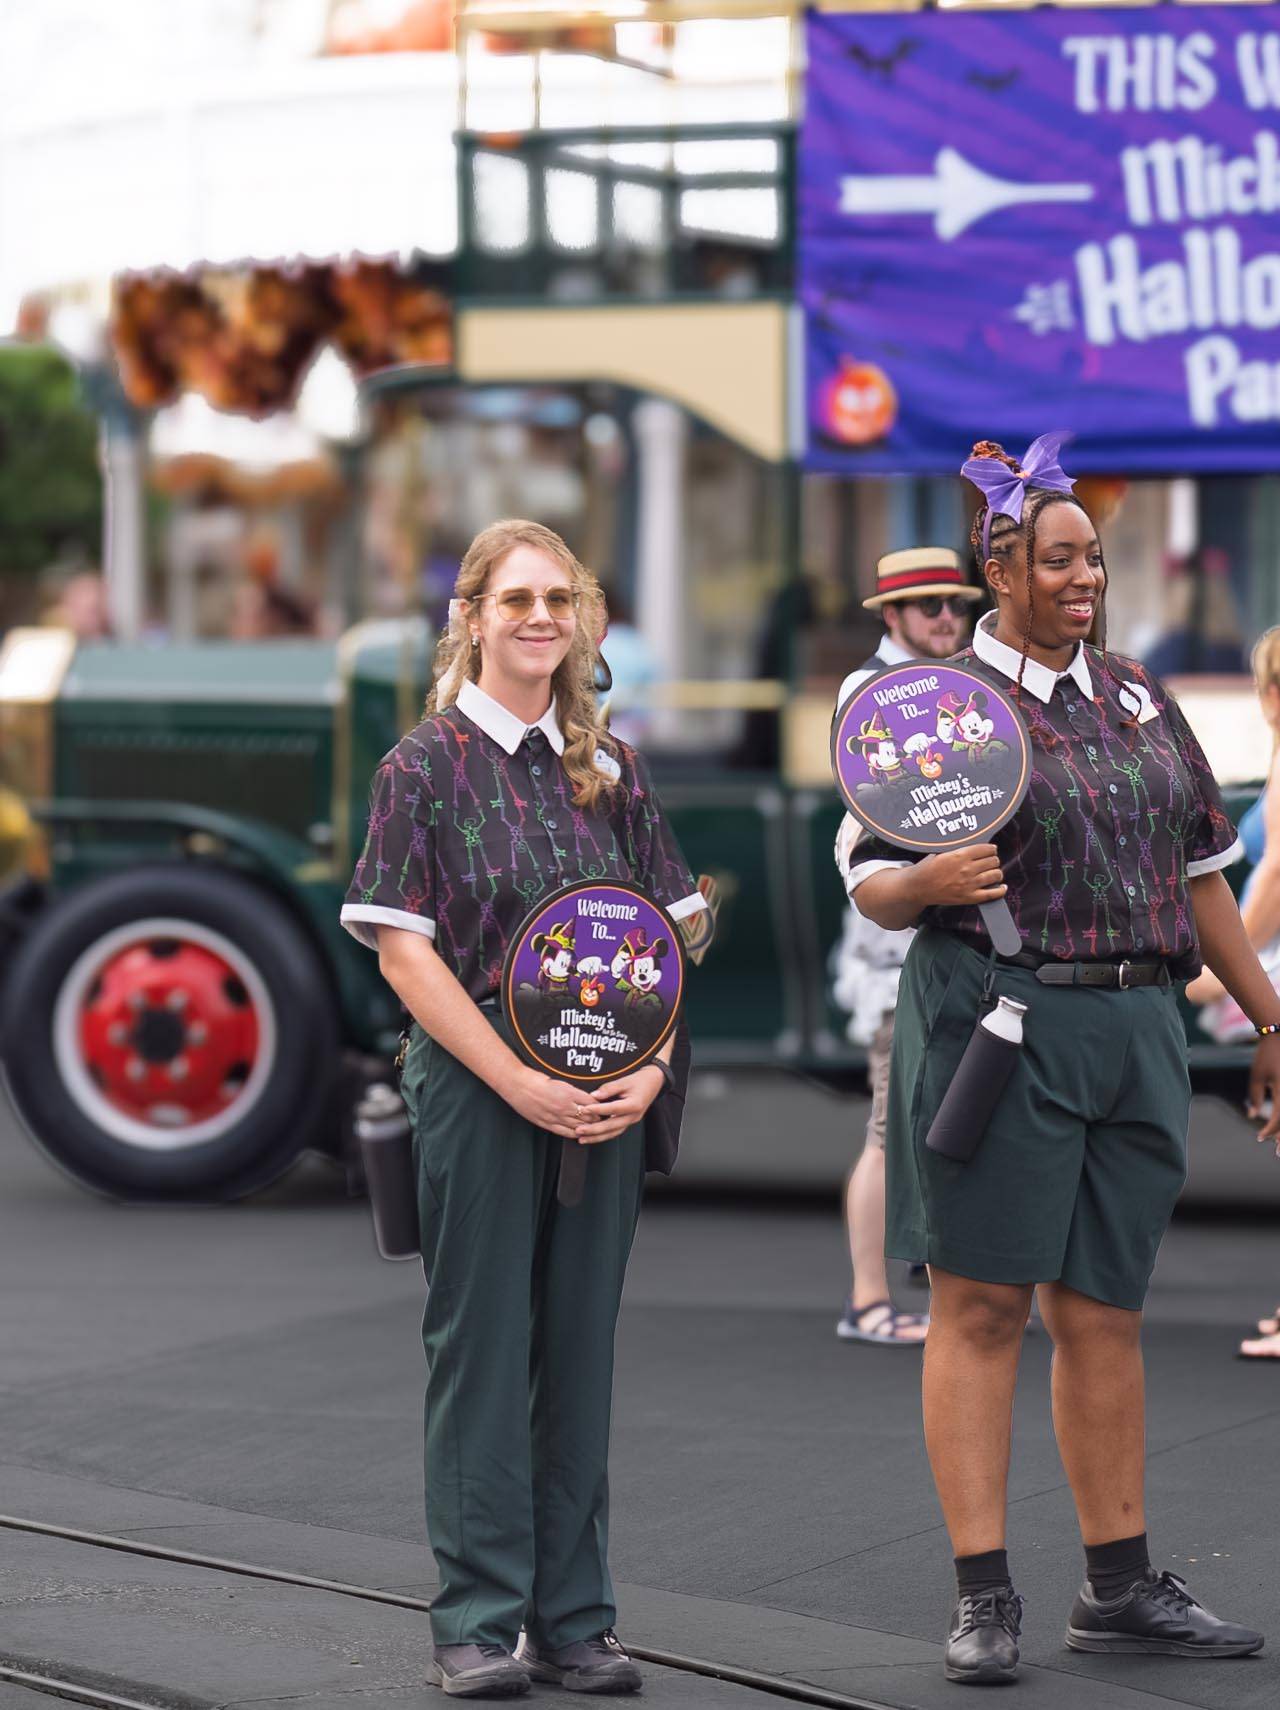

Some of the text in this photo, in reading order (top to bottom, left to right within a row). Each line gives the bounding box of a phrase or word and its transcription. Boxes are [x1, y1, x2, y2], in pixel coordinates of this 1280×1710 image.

[1062, 31, 1218, 114] THIS
[872, 675, 940, 707] Welcome
[910, 773, 971, 804] Mickey's
[908, 791, 993, 828] Halloween
[936, 812, 978, 836] Party
[577, 898, 638, 921] Welcome
[560, 1008, 615, 1031] Mickey's
[549, 1027, 626, 1054] Halloween
[566, 1049, 604, 1073] Party
